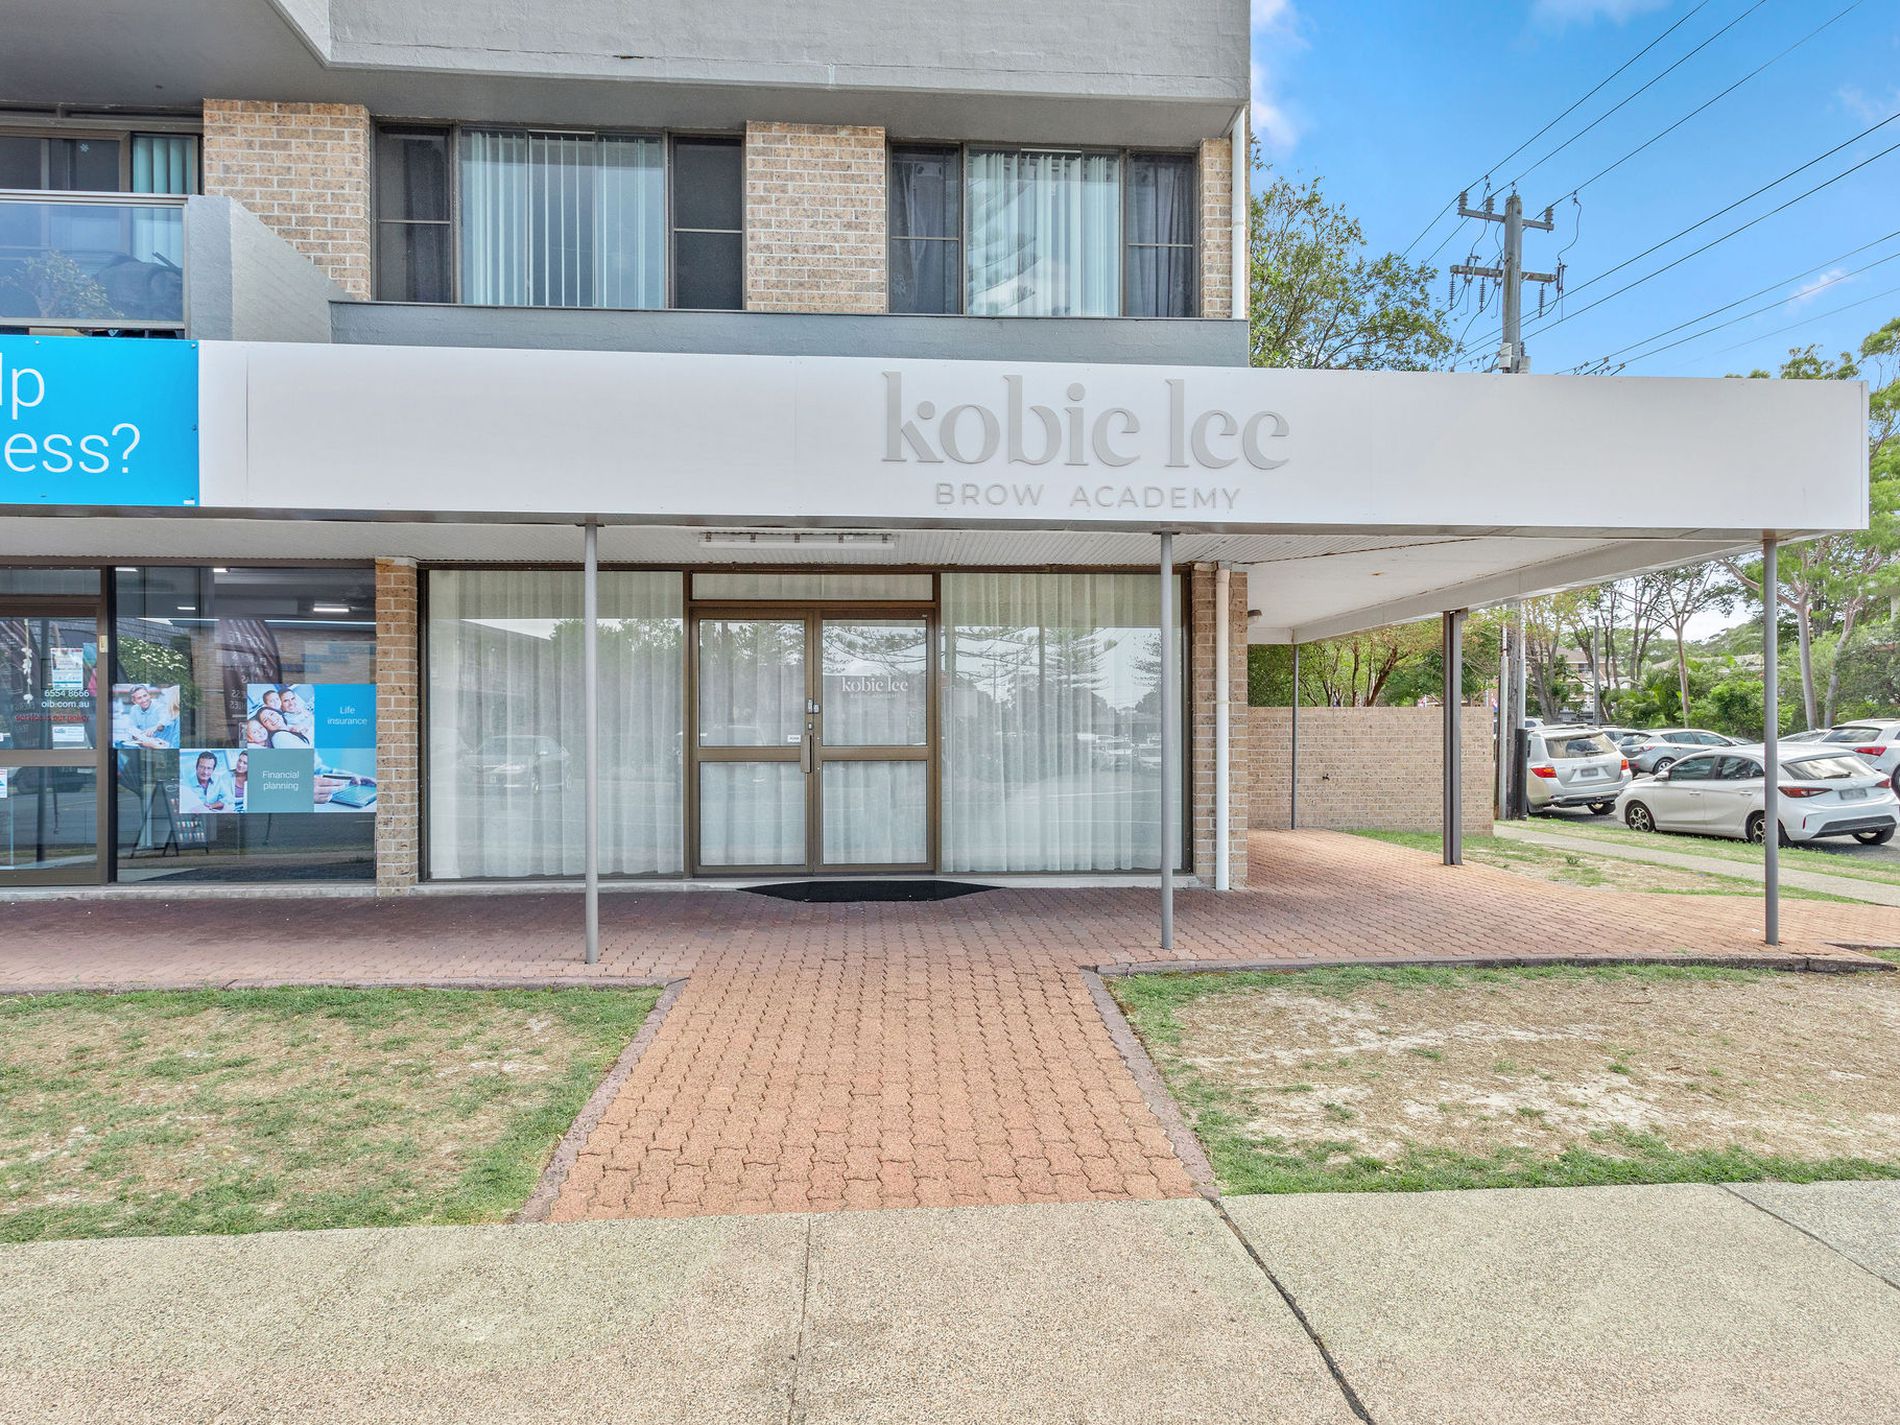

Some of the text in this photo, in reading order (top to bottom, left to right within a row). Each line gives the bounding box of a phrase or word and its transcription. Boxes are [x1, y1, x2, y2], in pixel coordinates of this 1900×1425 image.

[881, 371, 1290, 470] kobie lee
[4, 423, 141, 474] ess?
[935, 483, 1241, 510] BROW ACADEMY
[841, 677, 908, 692] kobie lee
[44, 689, 66, 698] 6554
[41, 700, 90, 708] oib.com.au
[339, 706, 356, 715] Life
[327, 717, 368, 726] insurance
[262, 770, 300, 779] Financial
[263, 782, 299, 792] planning
